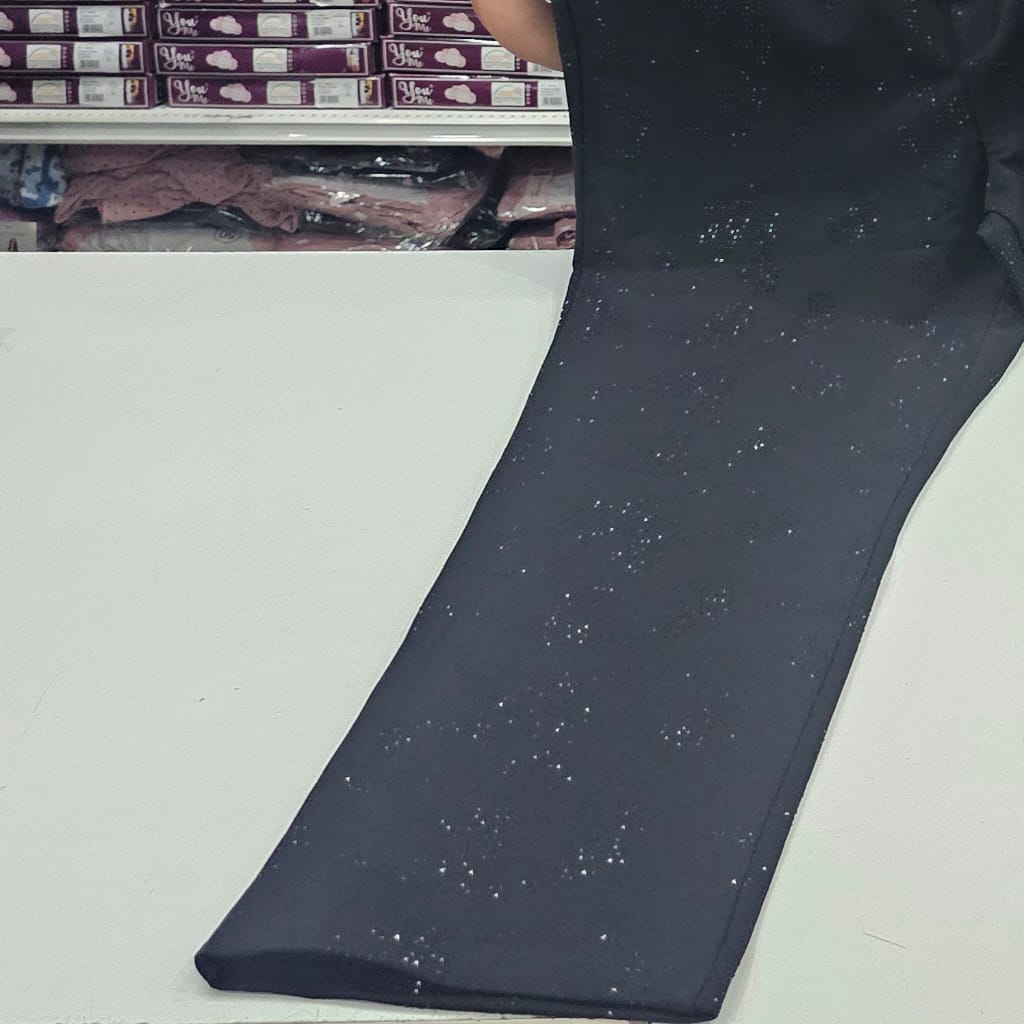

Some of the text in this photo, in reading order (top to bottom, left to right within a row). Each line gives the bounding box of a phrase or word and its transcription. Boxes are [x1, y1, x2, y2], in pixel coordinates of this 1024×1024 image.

[164, 12, 198, 35] You
[395, 7, 430, 31] You
[160, 47, 194, 70] You
[389, 43, 423, 66] You
[174, 80, 208, 103] You
[400, 81, 434, 103] You
